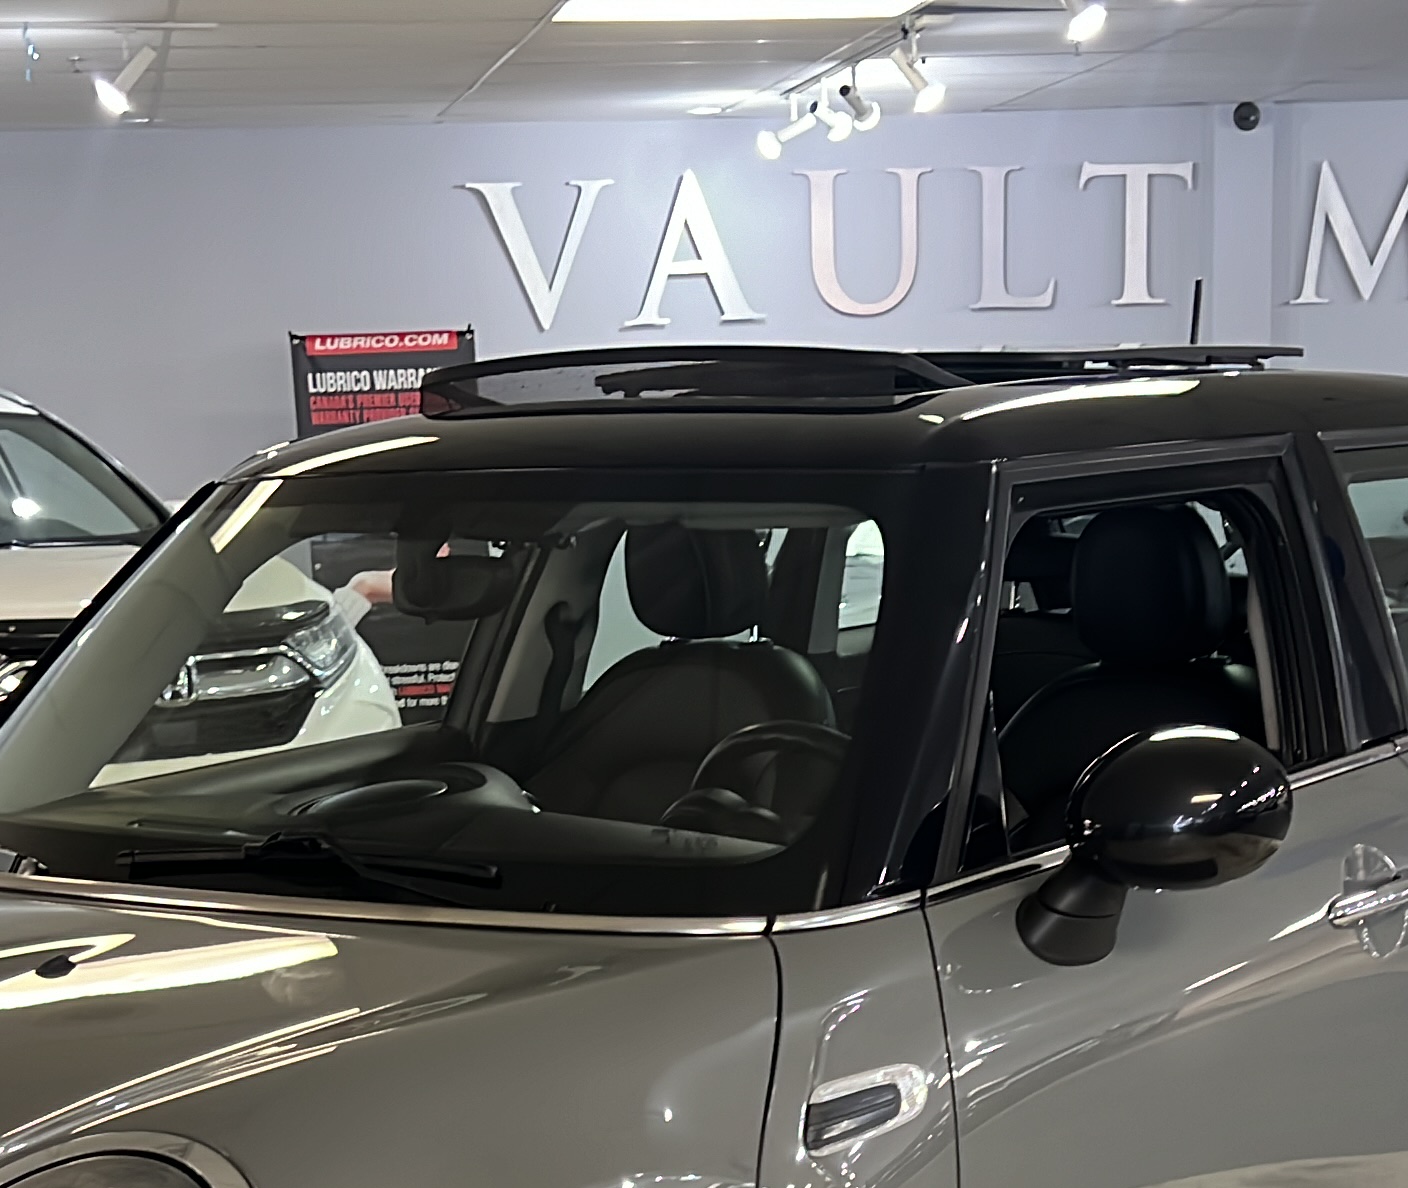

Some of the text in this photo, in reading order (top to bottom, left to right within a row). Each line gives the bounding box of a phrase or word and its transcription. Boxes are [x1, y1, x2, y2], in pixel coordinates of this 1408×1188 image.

[462, 160, 1196, 333] VAULT
[314, 332, 450, 351] LUBRICO.COM
[307, 367, 439, 393] LUBRICO WARRA
